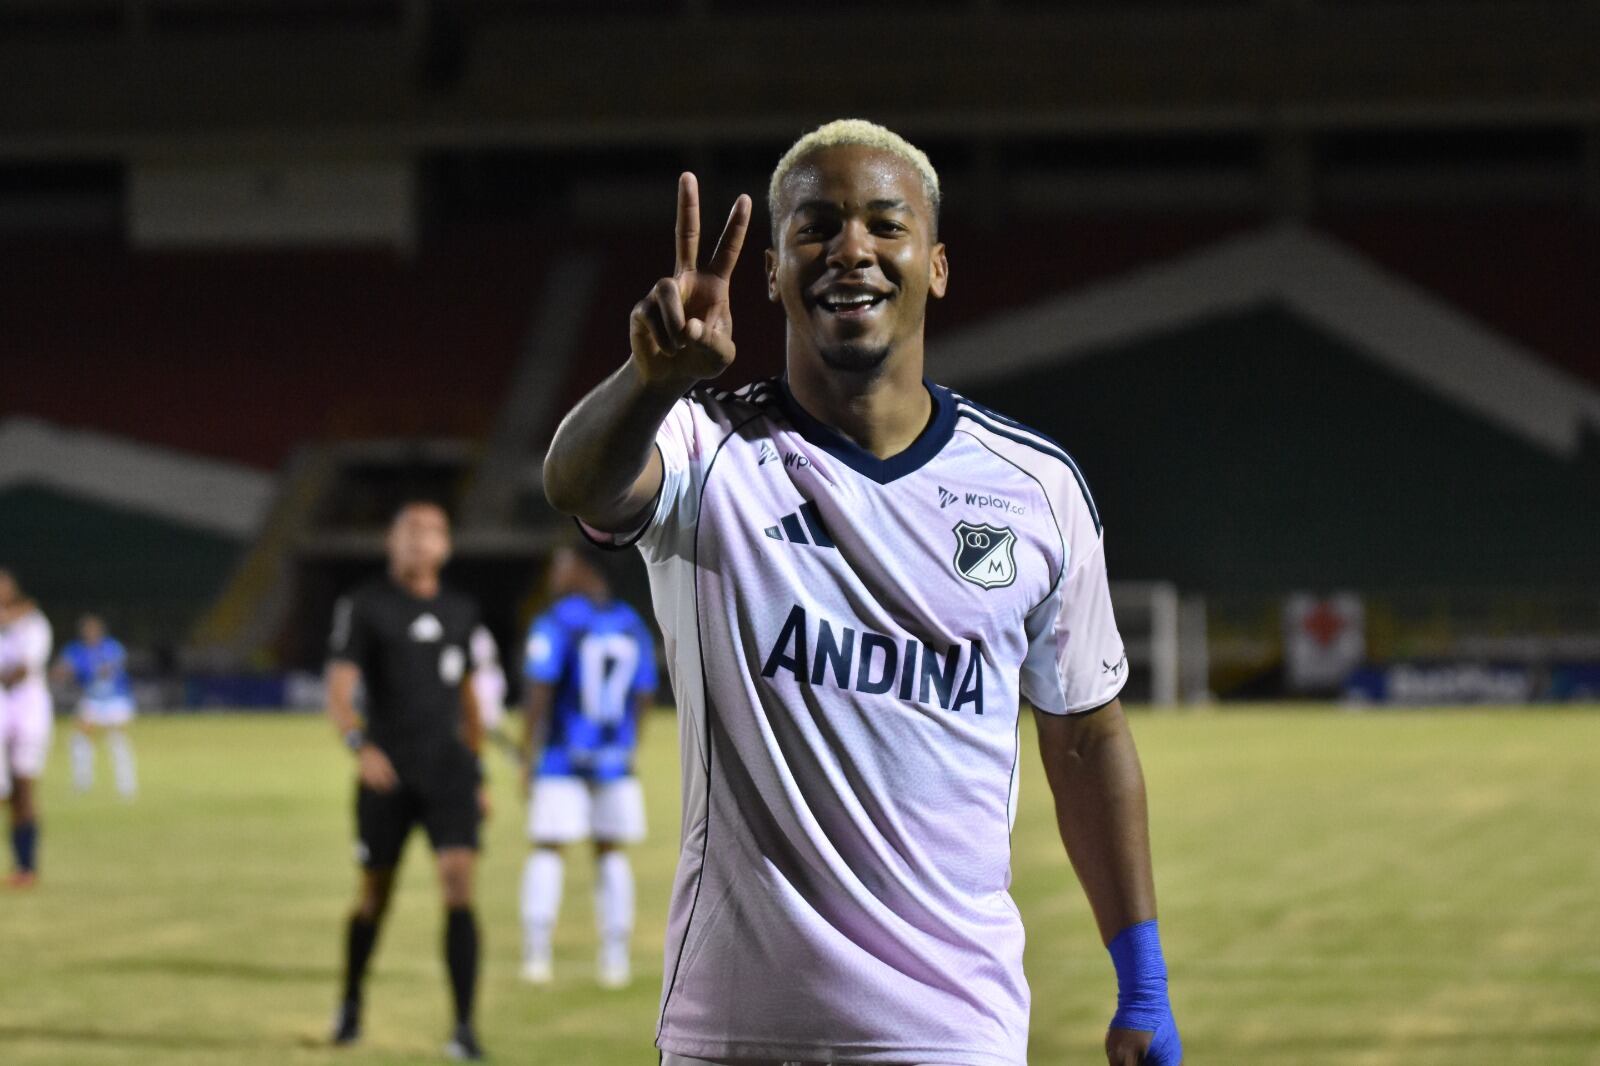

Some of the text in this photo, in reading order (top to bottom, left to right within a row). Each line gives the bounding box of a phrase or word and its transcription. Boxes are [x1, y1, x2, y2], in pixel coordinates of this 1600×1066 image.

[965, 492, 1025, 515] Wplay.co
[988, 560, 1004, 576] M
[762, 605, 984, 715] ANDINA
